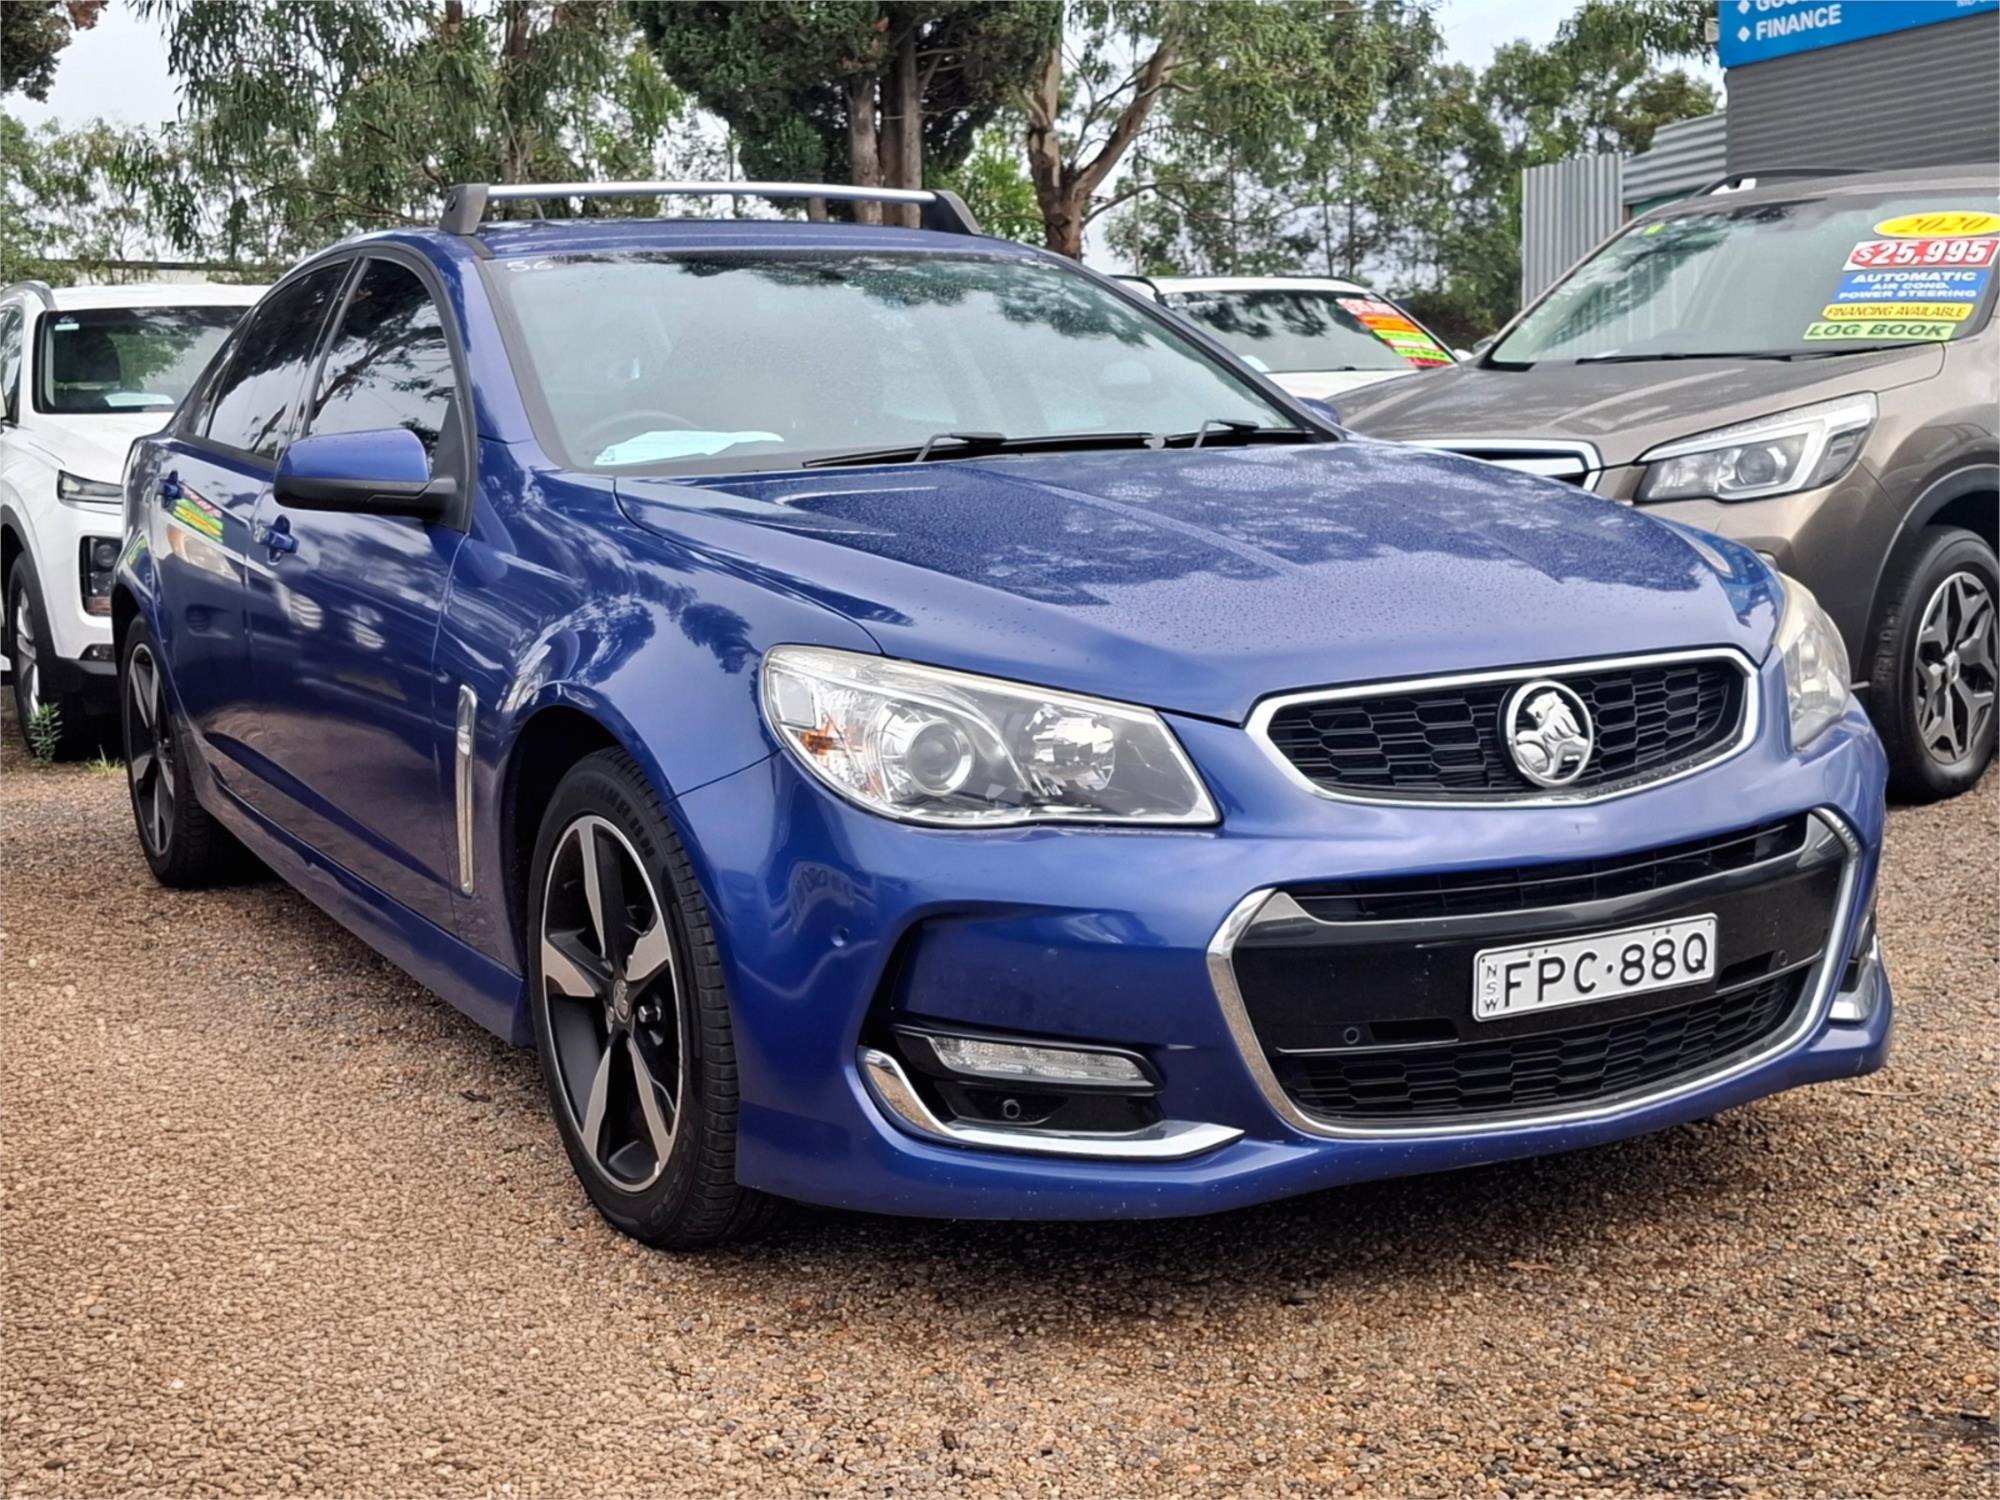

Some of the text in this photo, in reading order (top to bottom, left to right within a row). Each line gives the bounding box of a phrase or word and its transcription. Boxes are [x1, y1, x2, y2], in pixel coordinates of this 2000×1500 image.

[1755, 4, 1842, 41] FINANCE
[1894, 216, 1991, 233] 2020
[1853, 240, 1991, 265] $25,995
[1852, 271, 1977, 283] AUTOMATIC
[1870, 282, 1899, 290] AIR
[1838, 289, 1977, 299] POWER STEERING
[1826, 305, 1967, 317] FINANCING AVAILABLE
[1807, 324, 1951, 337] LOG BOOK
